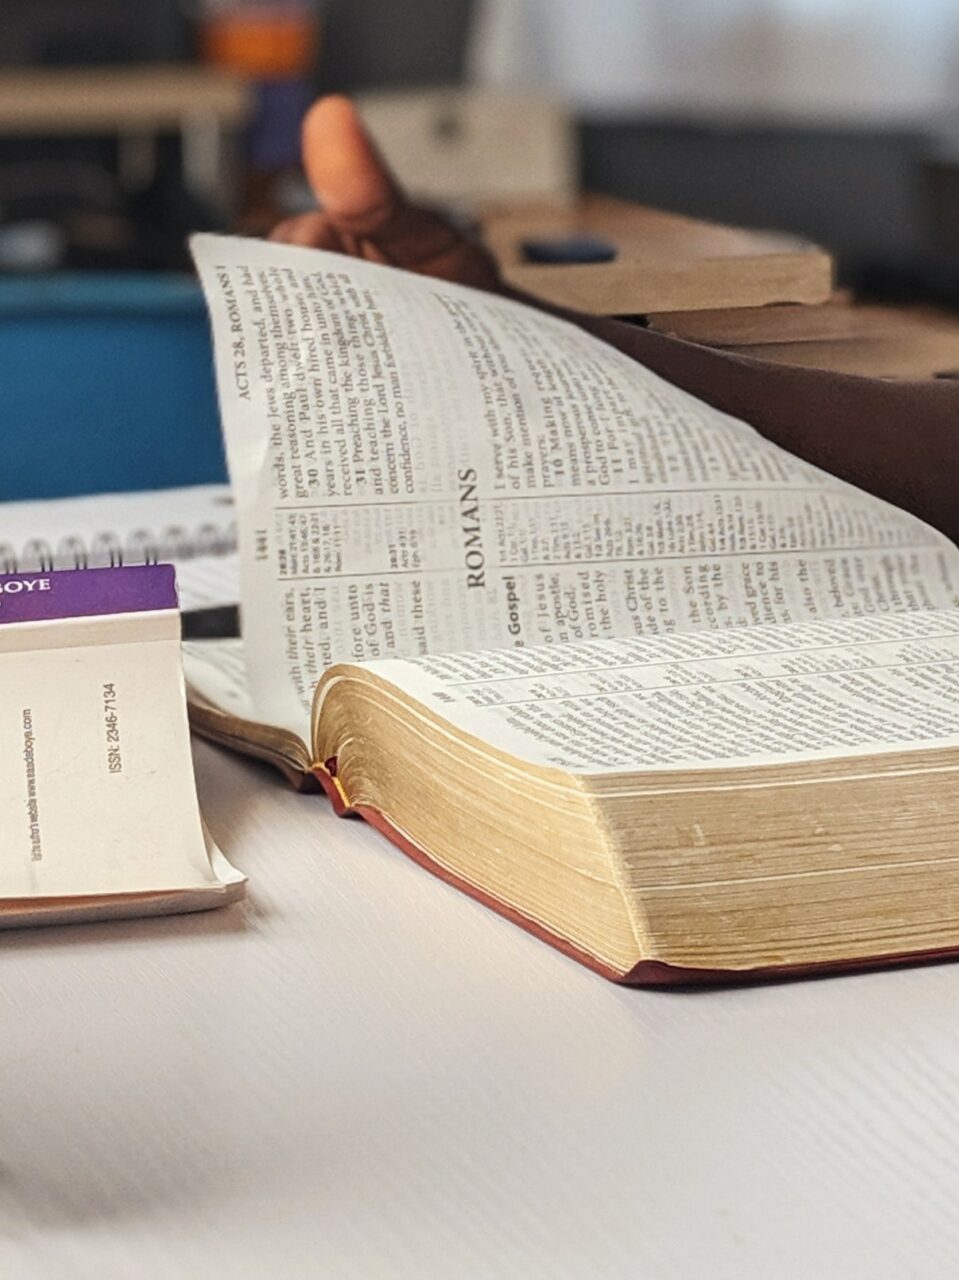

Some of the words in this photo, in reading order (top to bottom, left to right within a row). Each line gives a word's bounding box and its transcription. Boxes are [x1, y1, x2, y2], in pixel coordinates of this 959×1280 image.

[236, 266, 254, 285] had
[269, 267, 287, 301] whole
[282, 268, 298, 288] and
[313, 271, 329, 296] God,
[325, 272, 346, 305] which
[337, 273, 351, 284] all
[219, 273, 243, 333] ROMANS
[247, 291, 262, 312] and
[323, 298, 336, 309] of
[348, 287, 362, 308] with
[362, 289, 376, 310] him.
[285, 308, 296, 335] two
[313, 302, 327, 329] unto
[342, 309, 361, 348] things
[233, 337, 246, 357] 28,
[254, 318, 274, 382] departed,
[317, 333, 331, 345] in
[329, 313, 350, 367] kingdom
[373, 312, 397, 368] forbidding
[273, 343, 290, 388] among
[288, 342, 306, 381] dwelt
[304, 337, 320, 372] hired
[324, 349, 337, 384] came
[368, 350, 385, 379] Jesus
[468, 350, 488, 381] spirit
[475, 334, 499, 378] without
[498, 355, 513, 373] you
[235, 361, 250, 400] ACTS
[339, 371, 353, 391] the
[352, 354, 370, 392] those
[389, 372, 402, 398] man
[504, 377, 518, 389] of
[264, 387, 280, 417] Jews
[295, 387, 310, 421] Paul
[312, 378, 323, 408] own
[326, 388, 341, 415] that
[372, 384, 389, 413] Lord
[482, 383, 494, 405] my
[494, 381, 508, 407] that
[553, 396, 564, 407] at
[316, 414, 328, 434] his
[392, 401, 405, 418] no
[484, 409, 499, 437] with
[512, 393, 532, 446] mention
[540, 397, 562, 451] Making
[559, 410, 573, 438] now
[584, 403, 601, 436] come
[602, 389, 626, 432] impart
[266, 424, 282, 446] the
[283, 392, 300, 459] reasoning
[330, 419, 344, 435] all
[342, 397, 364, 463] Preaching
[362, 398, 380, 461] teaching
[379, 417, 392, 438] the
[503, 412, 516, 443] Son,
[571, 403, 597, 474] prosperous
[604, 427, 619, 451] For
[301, 430, 316, 461] And
[318, 440, 331, 454] in
[397, 421, 415, 493] confidence,
[504, 448, 518, 469] his
[594, 439, 604, 453] to
[622, 441, 637, 470] may
[274, 452, 289, 499] words,
[334, 439, 352, 496] received
[385, 442, 399, 494] concern
[491, 443, 504, 479] serve
[525, 451, 537, 488] make
[552, 458, 565, 476] 10
[565, 441, 581, 487] means
[595, 456, 610, 486] God
[612, 457, 624, 474] 11
[291, 459, 309, 498] great
[307, 468, 319, 487] 30
[321, 460, 340, 497] years
[356, 469, 366, 485] 31
[369, 467, 384, 495] and
[509, 474, 521, 490] of
[457, 468, 486, 589] ROMANS
[255, 529, 268, 561] 1441
[637, 567, 650, 591] the
[653, 567, 665, 591] the
[682, 564, 695, 594] Son
[711, 563, 724, 587] the
[740, 561, 755, 597] grace
[755, 561, 765, 576] to
[768, 561, 780, 582] his
[796, 558, 809, 582] the
[824, 558, 845, 608] beloved
[0, 579, 50, 593] OYE
[362, 583, 373, 595] is
[377, 582, 391, 613] that
[409, 580, 424, 619] these
[535, 573, 550, 617] Jesus
[550, 572, 568, 626] apostle,
[594, 570, 608, 602] holy
[624, 568, 639, 612] Christ
[697, 564, 719, 630] ccording
[758, 577, 777, 624] dience
[773, 586, 784, 604] for
[803, 586, 817, 613] also
[283, 587, 296, 622] ears,
[299, 587, 313, 632] heart,
[314, 600, 328, 629] and
[348, 584, 360, 620] unto
[502, 576, 521, 635] Gospel
[578, 571, 599, 638] romised
[642, 593, 655, 610] of
[659, 598, 669, 612] to
[688, 599, 701, 623] the
[715, 593, 729, 610] by
[362, 602, 377, 636] God
[570, 624, 583, 639] of
[597, 608, 611, 630] the
[632, 615, 645, 635] sus
[285, 626, 299, 660] their
[366, 640, 381, 657] of
[381, 620, 396, 648] and
[411, 626, 428, 655] said
[538, 627, 554, 643] of
[302, 638, 317, 674] their
[289, 666, 305, 694] with
[103, 683, 119, 742] 2346-7134
[108, 745, 121, 773] ISSN:
